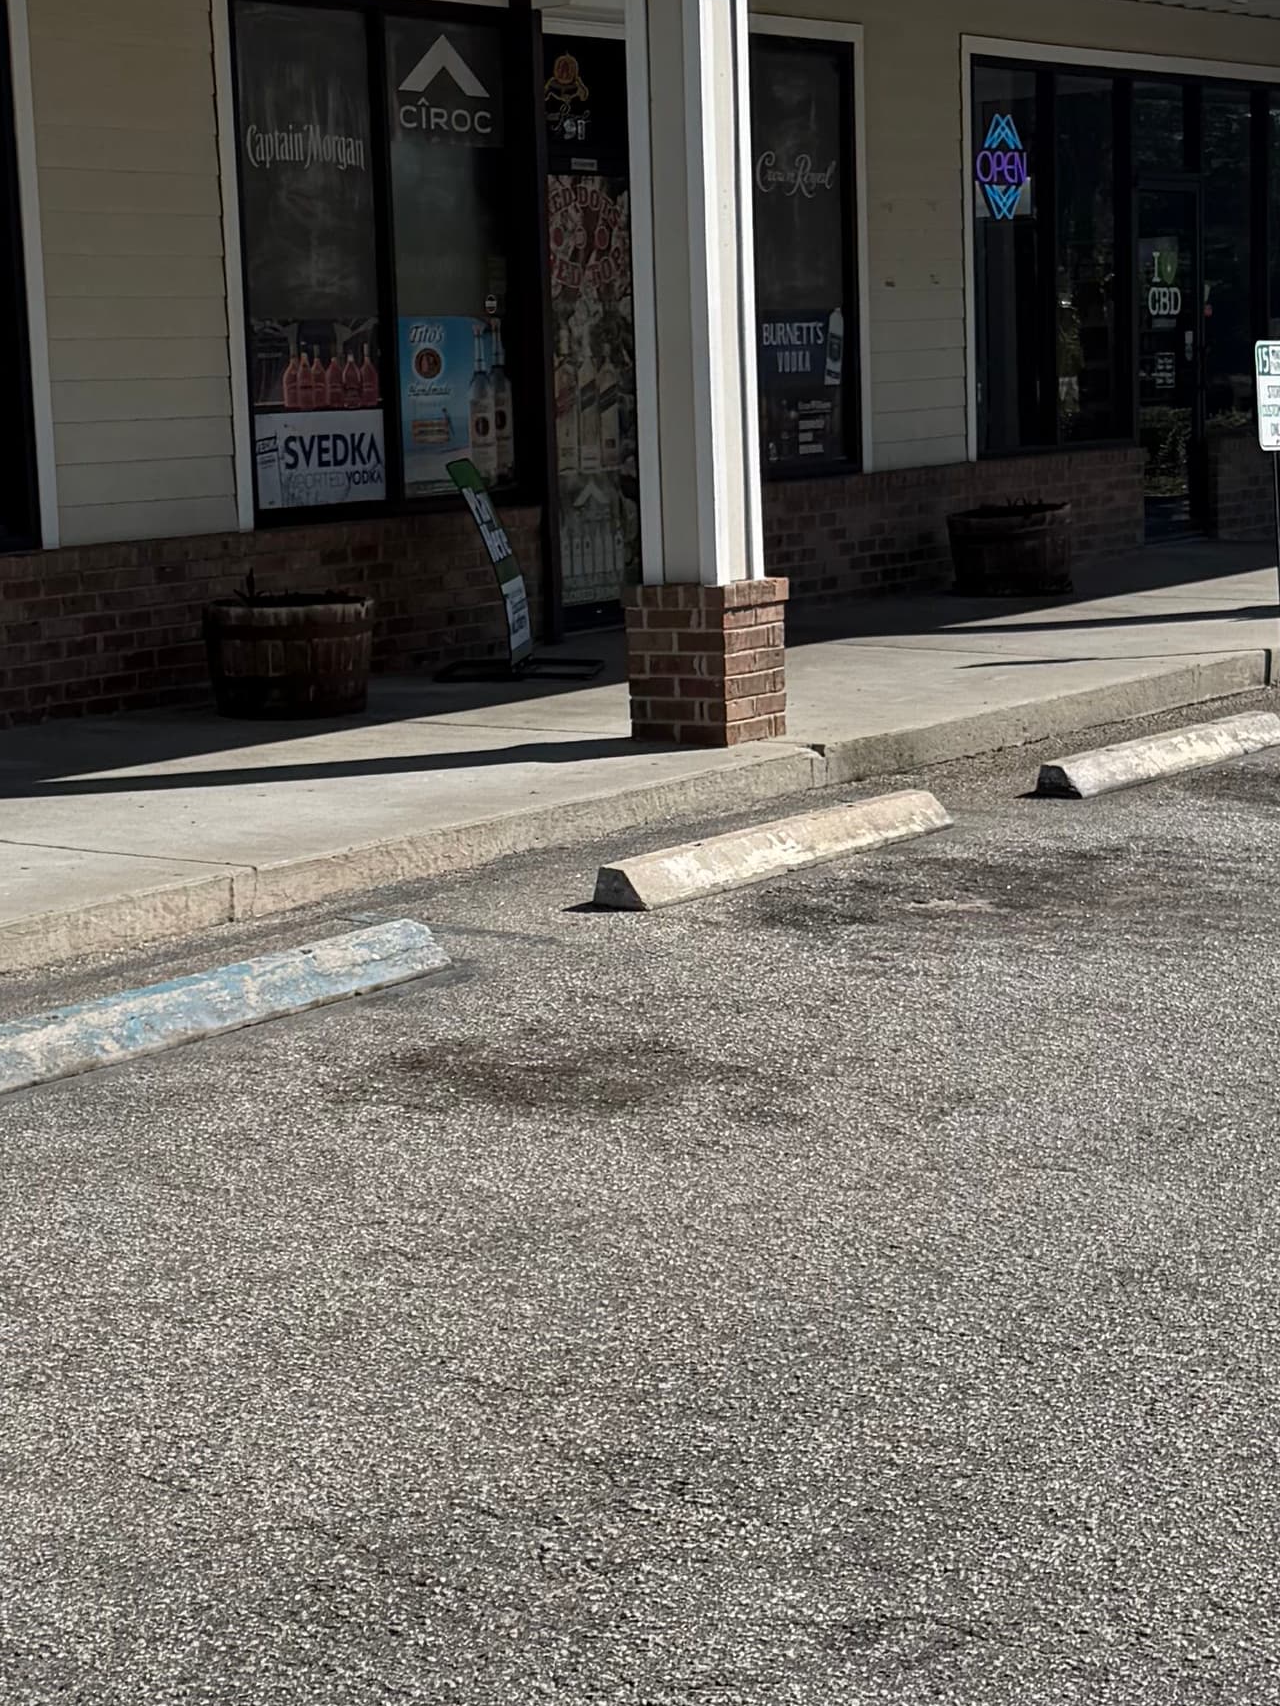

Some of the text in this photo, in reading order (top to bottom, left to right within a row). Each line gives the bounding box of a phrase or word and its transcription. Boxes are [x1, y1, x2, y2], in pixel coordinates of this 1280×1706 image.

[245, 124, 366, 171] Captain Morgan
[975, 149, 1028, 185] OPEN
[1148, 286, 1182, 316] CBD
[776, 350, 812, 373] VODKA
[1258, 347, 1270, 373] 15
[283, 432, 382, 470] SVEDKA
[344, 469, 384, 487] VODKA
